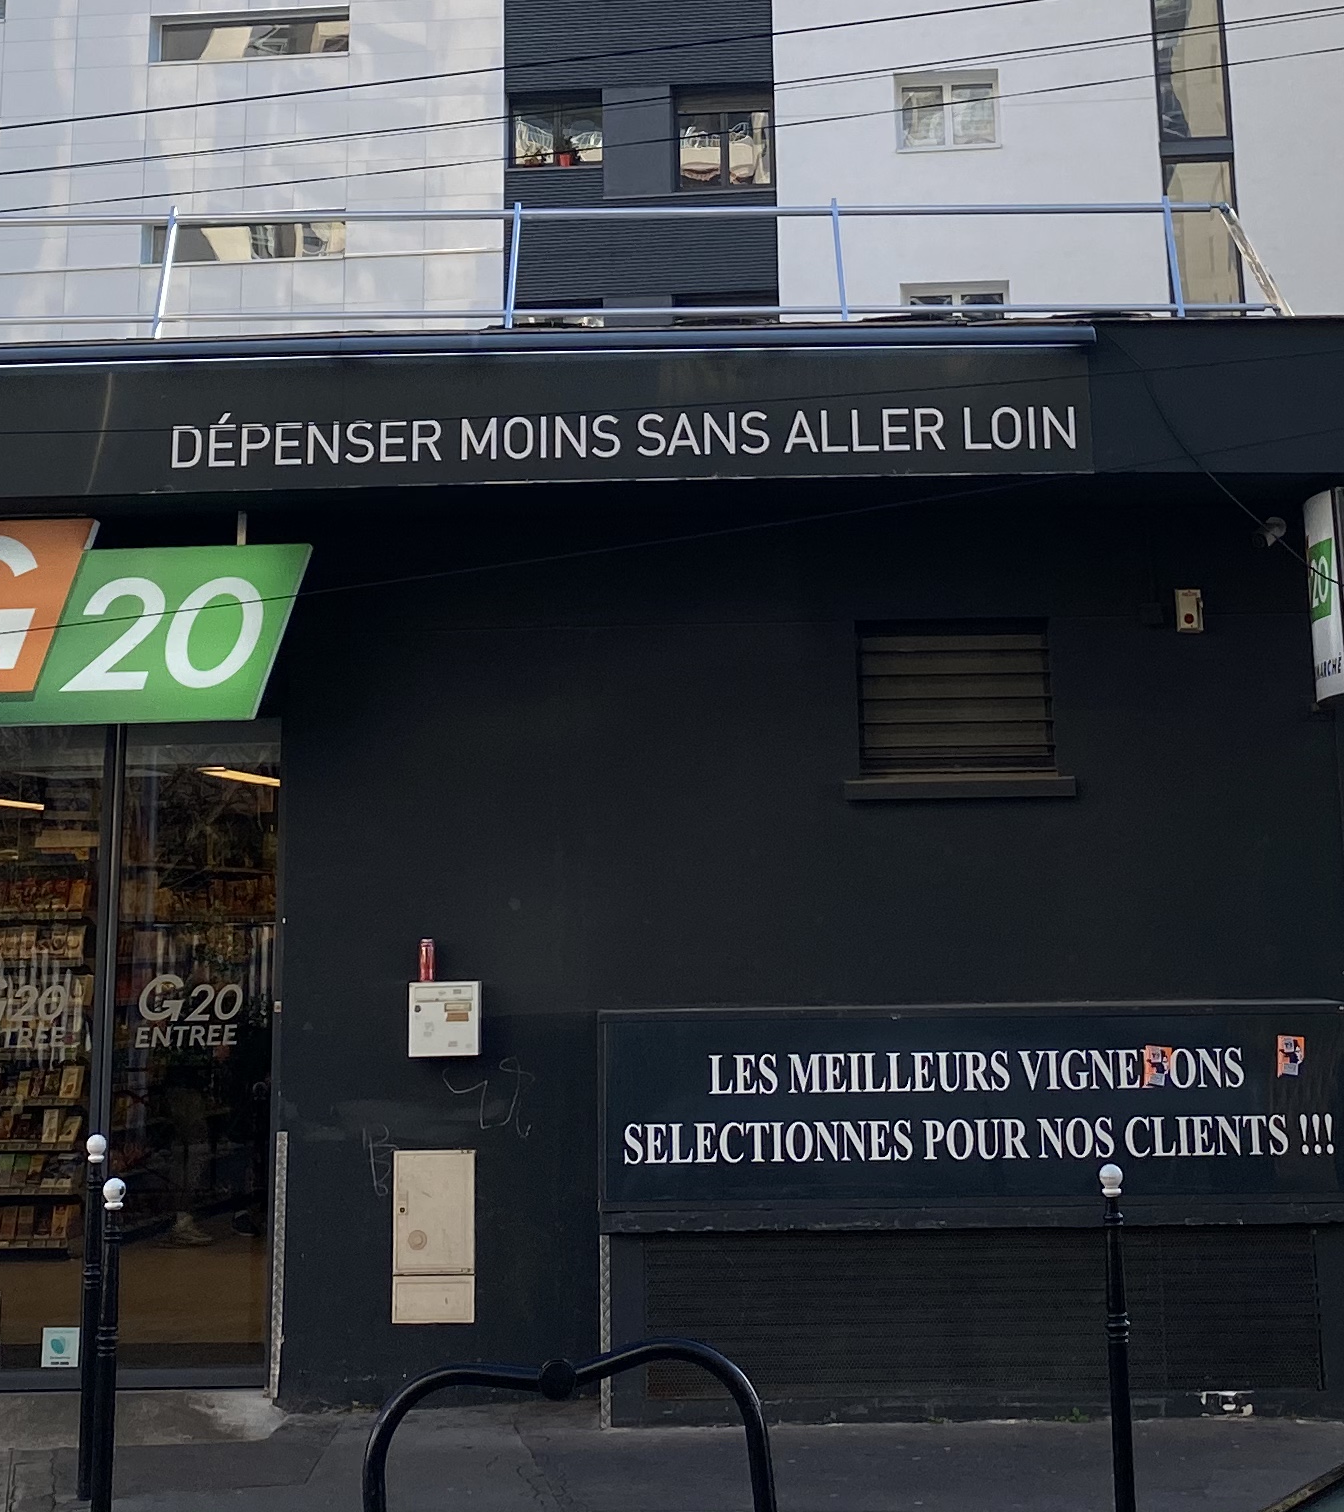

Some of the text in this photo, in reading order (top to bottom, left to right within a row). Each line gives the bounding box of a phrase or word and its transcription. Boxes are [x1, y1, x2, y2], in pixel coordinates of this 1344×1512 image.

[170, 405, 1078, 470] DÉPENSER MOINS SANS ALLER LOIN
[135, 1024, 239, 1049] ENTREE
[708, 1047, 1246, 1096] LES MEILLEURS VIGNEONS
[623, 1112, 1336, 1166] SELECTIONNES POUR NOS CLIENTS !!!
